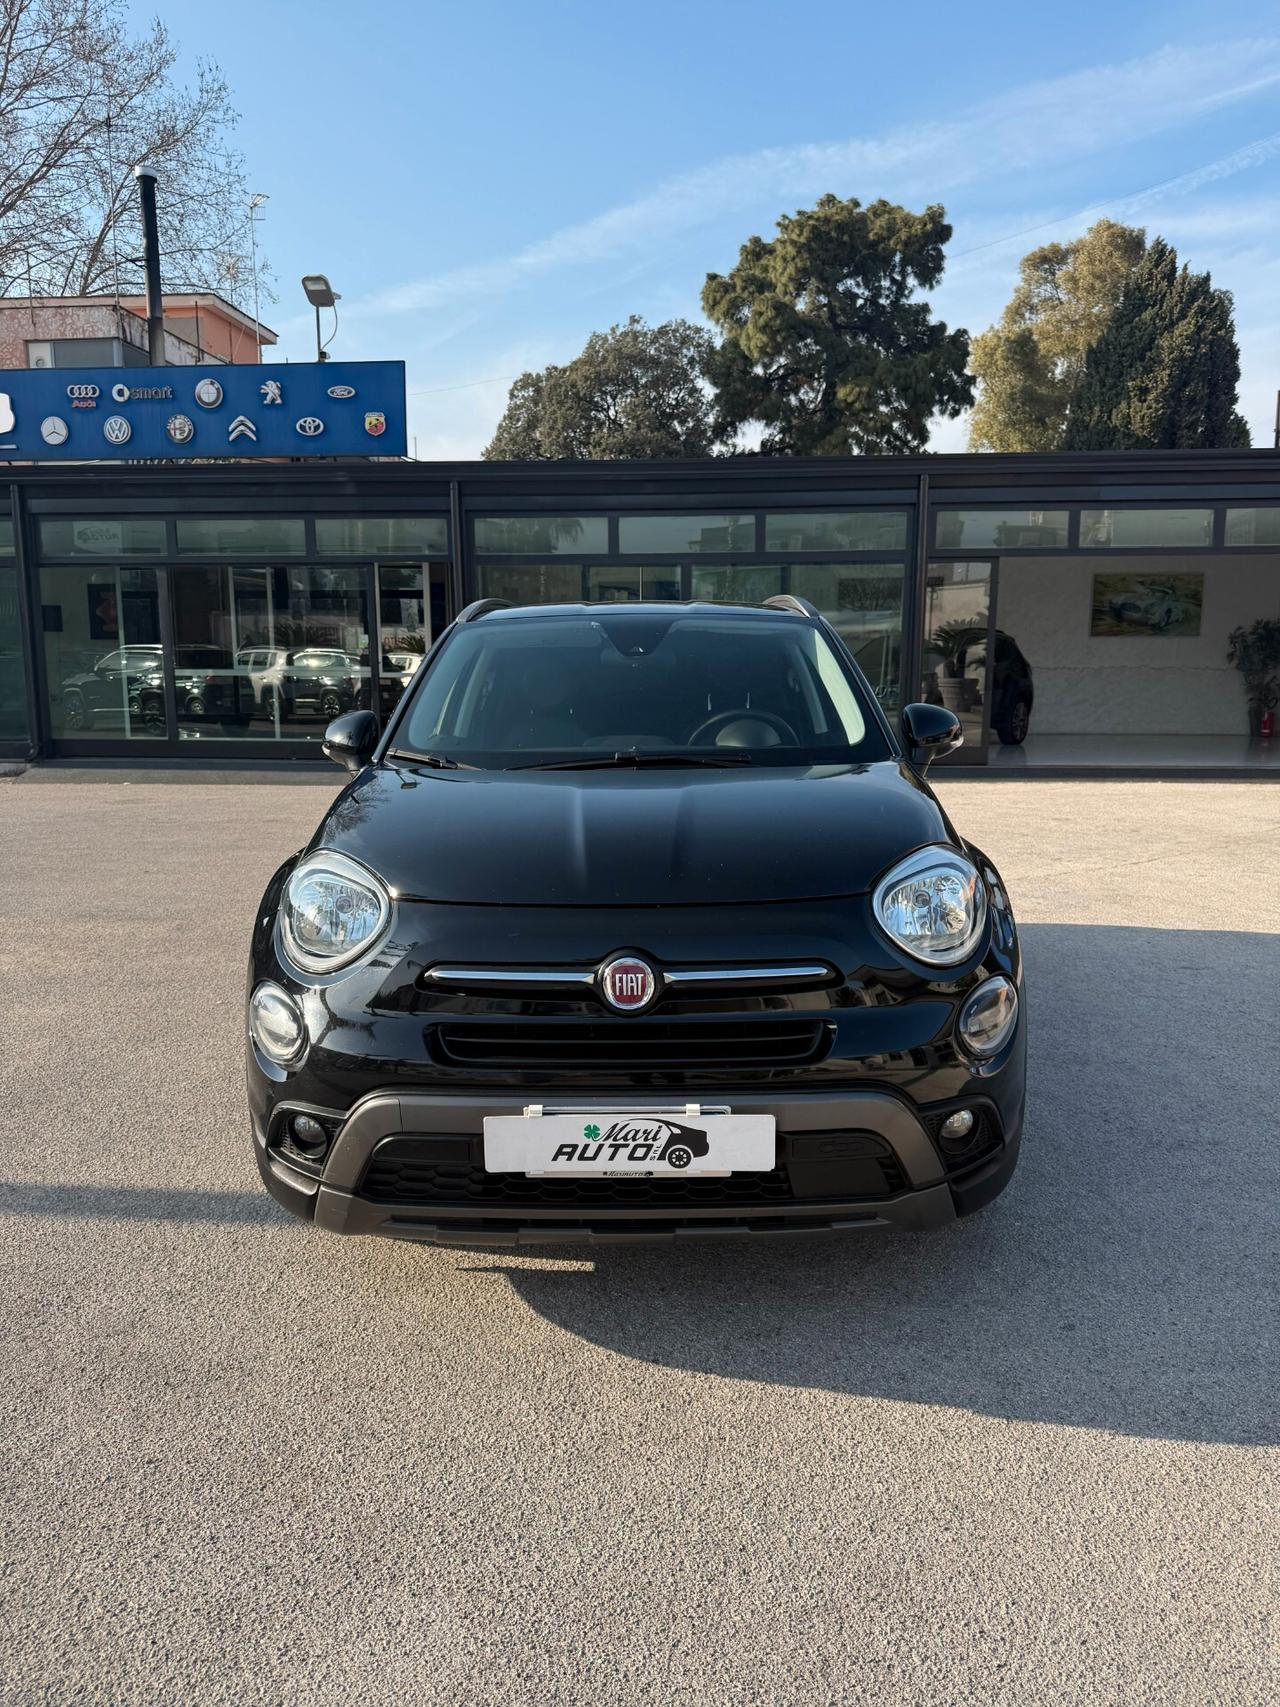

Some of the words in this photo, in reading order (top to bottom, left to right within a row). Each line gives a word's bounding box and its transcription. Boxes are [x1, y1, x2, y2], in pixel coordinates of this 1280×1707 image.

[130, 386, 173, 399] smart
[71, 399, 96, 408] Audi
[615, 973, 645, 996] FIAT
[593, 1122, 663, 1142] Mari
[551, 1143, 655, 1161] AUTO
